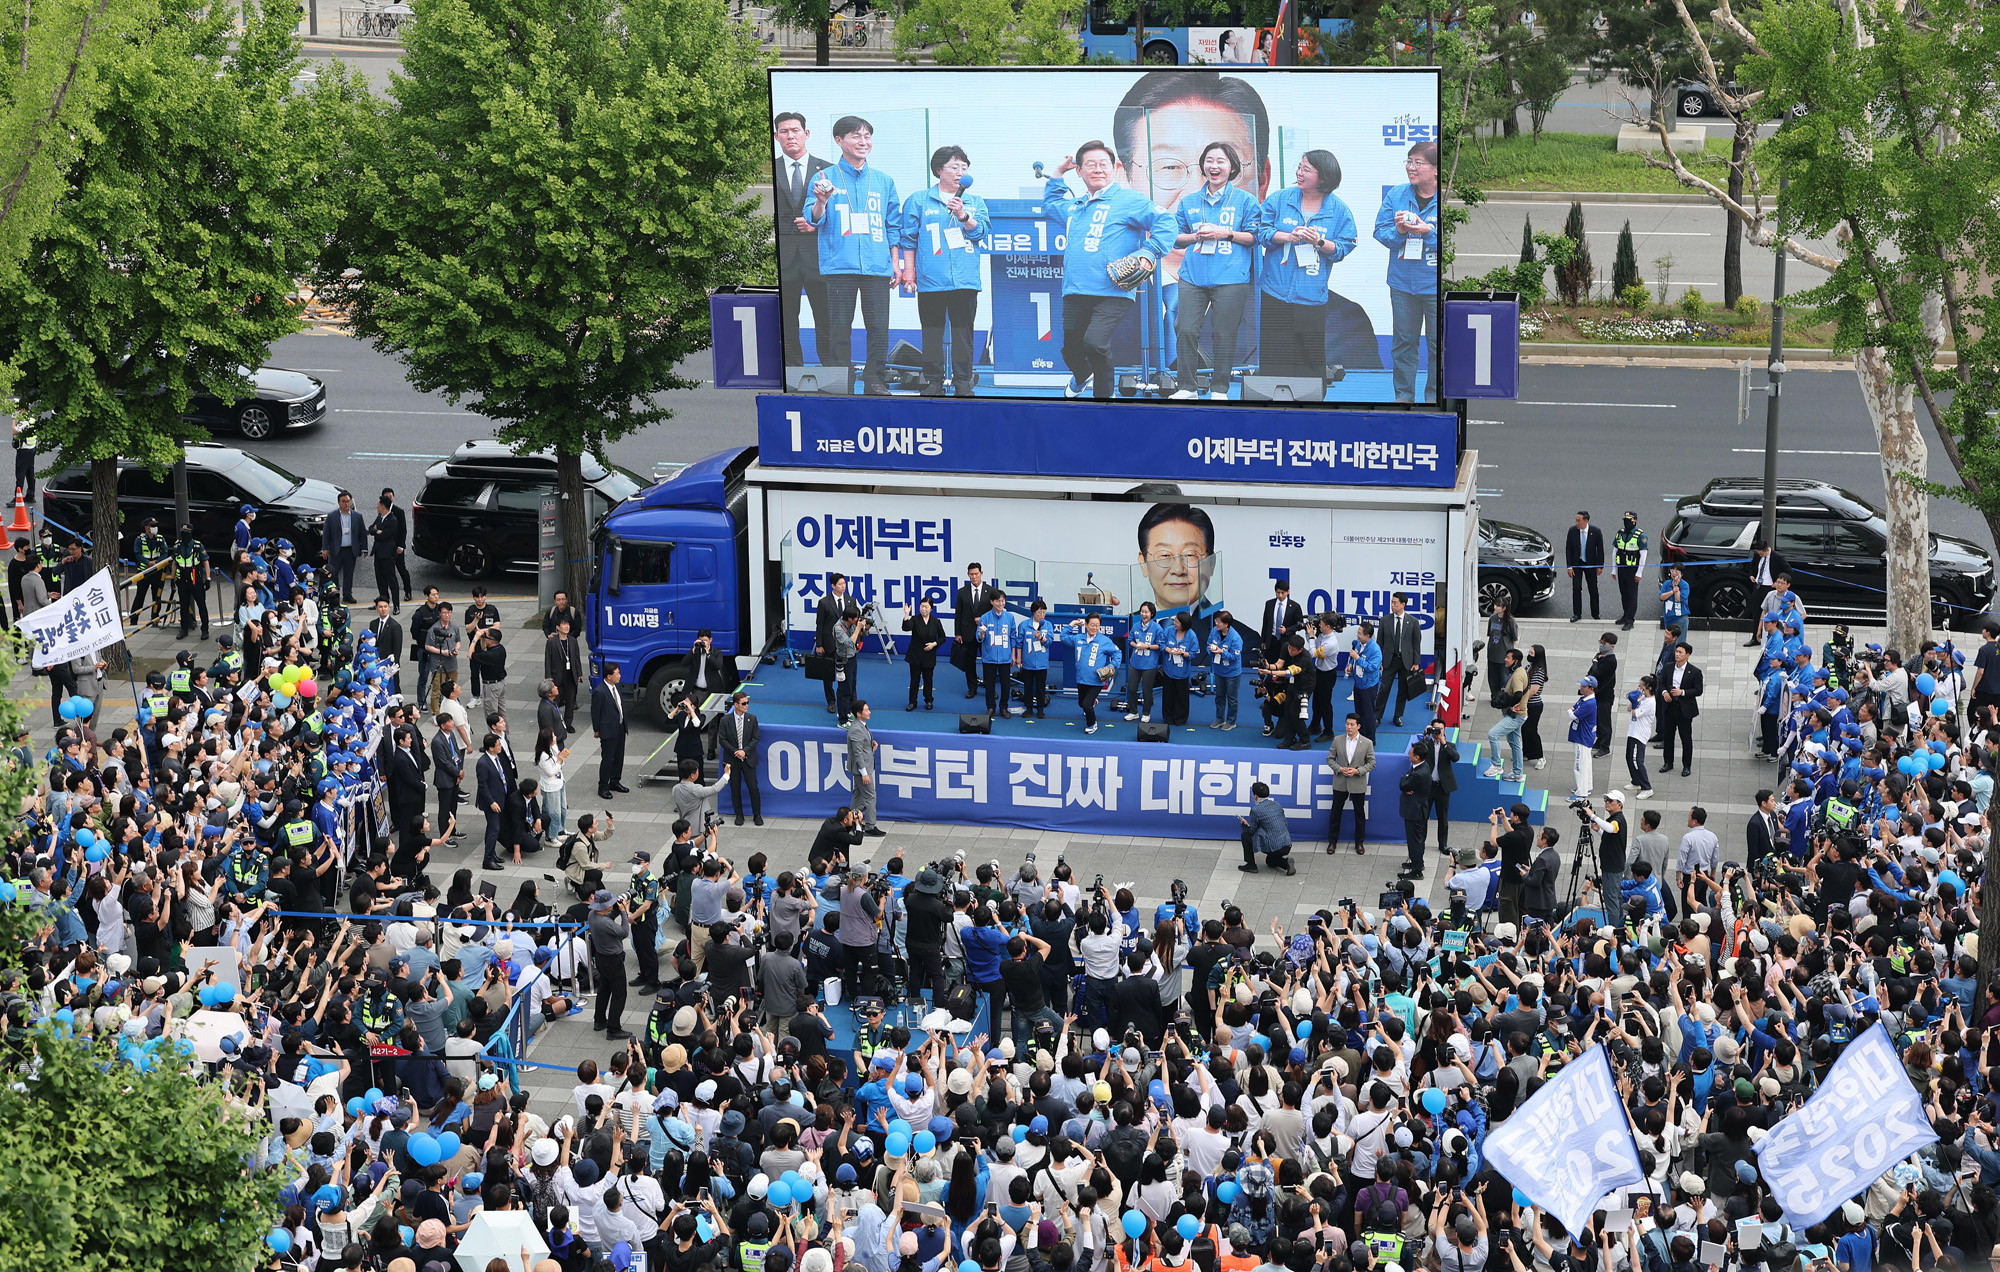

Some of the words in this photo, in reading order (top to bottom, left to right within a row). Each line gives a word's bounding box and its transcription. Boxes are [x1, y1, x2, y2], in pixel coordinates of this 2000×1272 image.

[1393, 113, 1421, 126] 더불어
[835, 203, 850, 236] 1
[868, 197, 884, 242] 이재명
[1034, 221, 1047, 252] 1
[1083, 209, 1108, 252] 이재명
[1217, 211, 1236, 255] 이명
[925, 222, 942, 255] 1
[1006, 266, 1029, 279] 진짜
[1030, 266, 1064, 279] 대한민
[1030, 292, 1051, 341] 1
[732, 306, 759, 376] 1
[1467, 314, 1492, 386] 1
[785, 410, 802, 452] 1
[816, 439, 856, 453] 지금은
[857, 426, 944, 457] 이재명
[1187, 436, 1283, 467] 이제부터
[1288, 439, 1338, 469] 진짜
[1340, 441, 1440, 472] 대한민국
[796, 513, 952, 563] 이제부터
[1269, 535, 1306, 548] 민주당
[1390, 571, 1436, 586] 지금은
[884, 575, 1043, 620] 대한국
[604, 605, 613, 626] 1
[620, 612, 660, 628] 이재명
[1098, 625, 1114, 635] 재명
[1009, 752, 1123, 811] 진짜
[1651, 886, 1662, 907] 1
